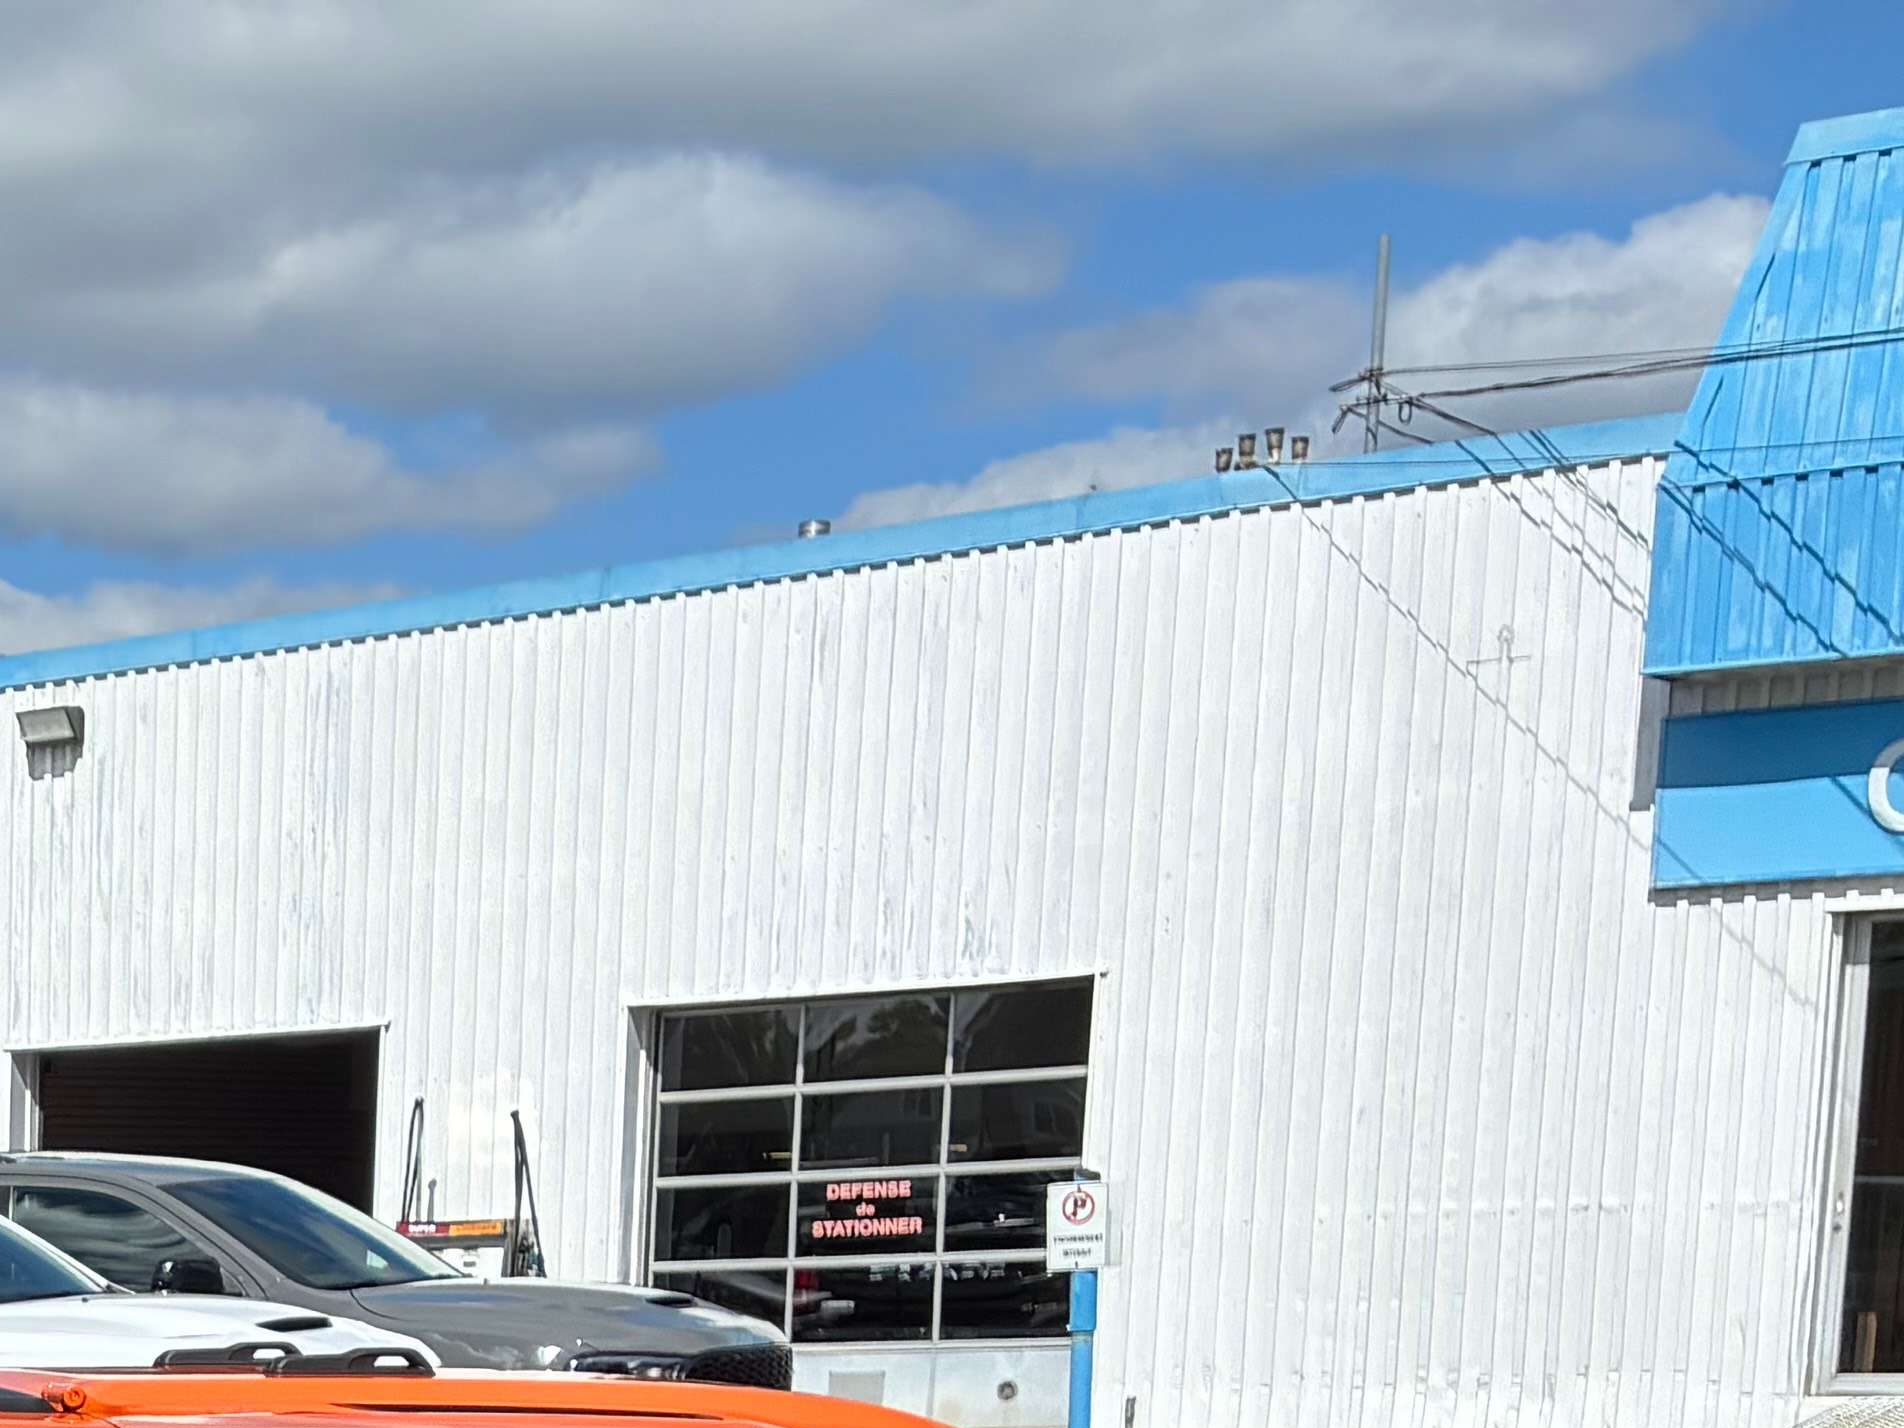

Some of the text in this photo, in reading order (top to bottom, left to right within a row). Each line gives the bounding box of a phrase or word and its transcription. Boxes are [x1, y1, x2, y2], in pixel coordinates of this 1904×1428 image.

[826, 1180, 911, 1200] DEFENSE
[855, 1202, 876, 1216] de
[812, 1217, 923, 1238] STATIONNER
